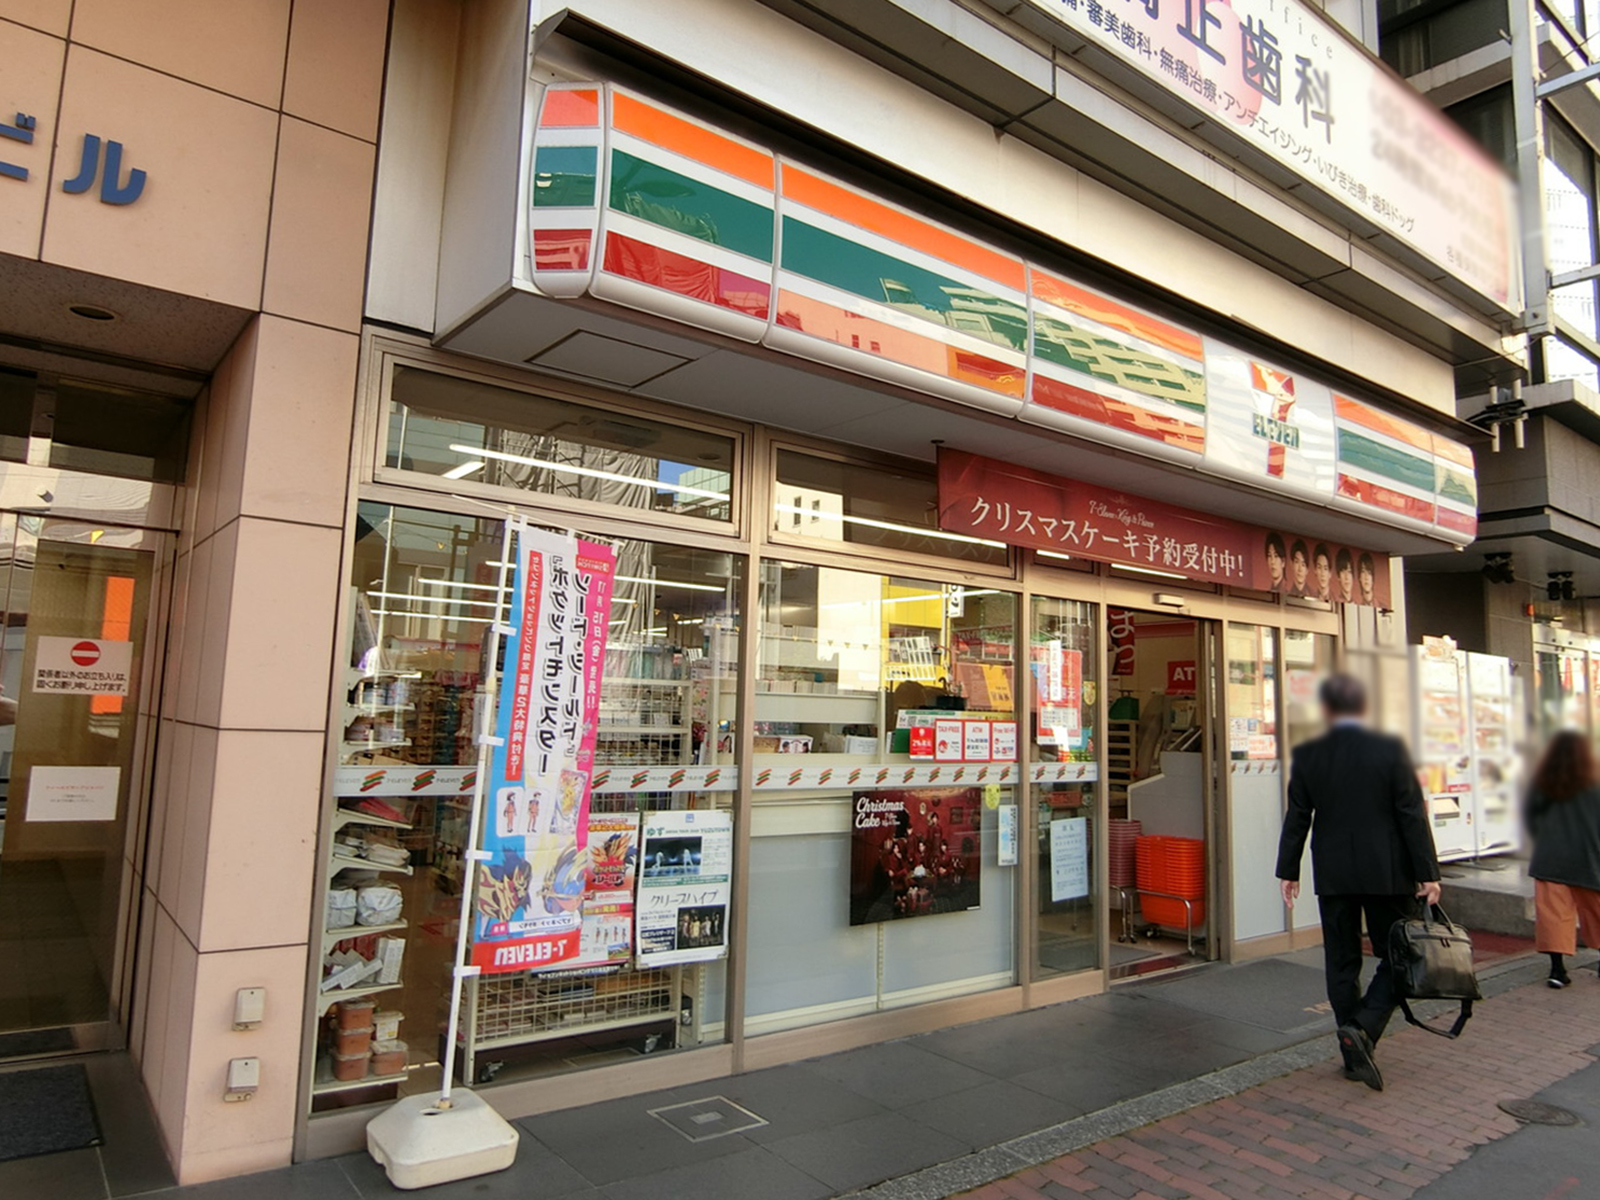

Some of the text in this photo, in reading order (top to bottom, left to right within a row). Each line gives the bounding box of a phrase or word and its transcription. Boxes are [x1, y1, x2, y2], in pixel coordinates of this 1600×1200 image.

[1124, 0, 1335, 145] 正歯科
[970, 496, 1244, 577] クリスマスケーキ予約受付中!
[1173, 667, 1196, 681] AT
[856, 796, 905, 813] Christmas
[855, 812, 880, 829] Cake
